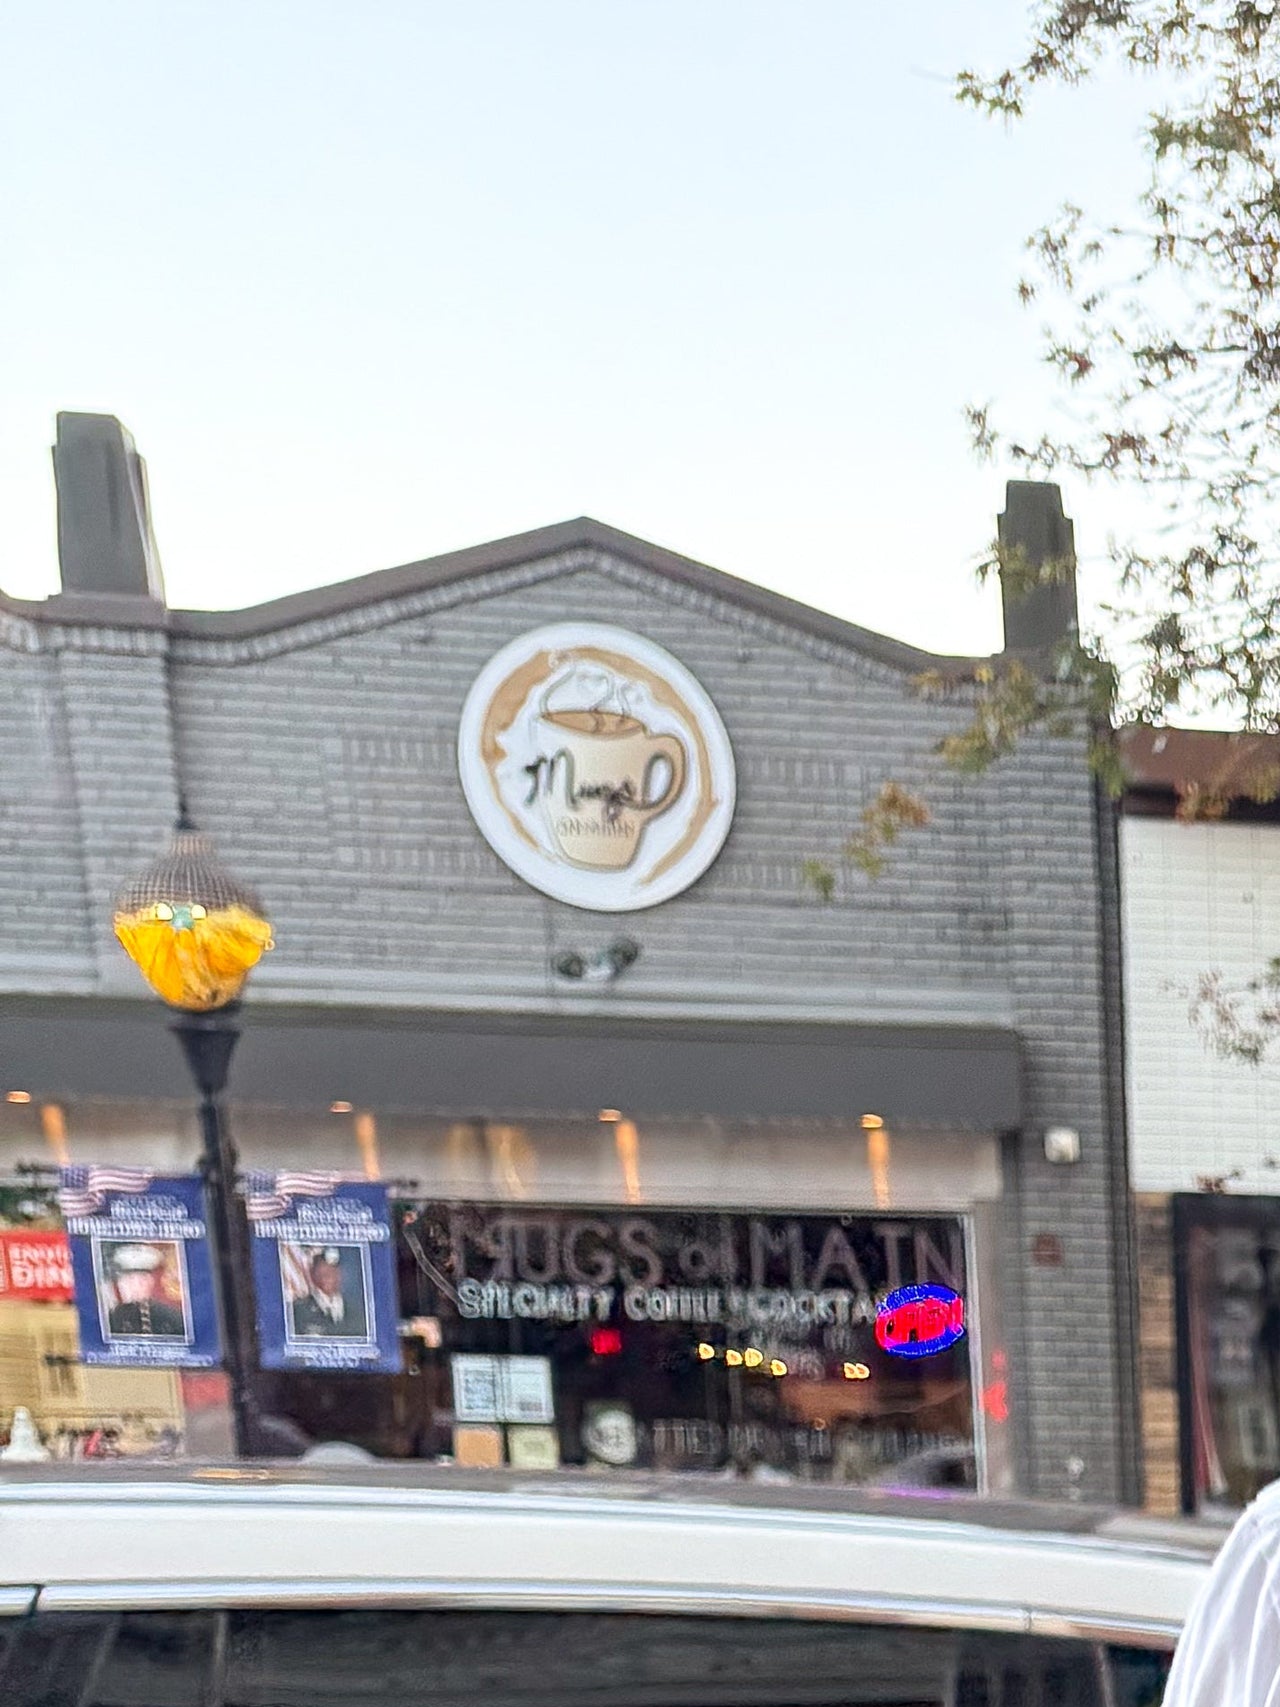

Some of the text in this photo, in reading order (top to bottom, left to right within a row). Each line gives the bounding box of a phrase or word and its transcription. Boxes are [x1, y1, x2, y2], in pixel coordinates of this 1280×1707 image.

[450, 1215, 663, 1287] MUGS
[750, 1217, 962, 1297] MAIN
[875, 1298, 964, 1349] OPEN
